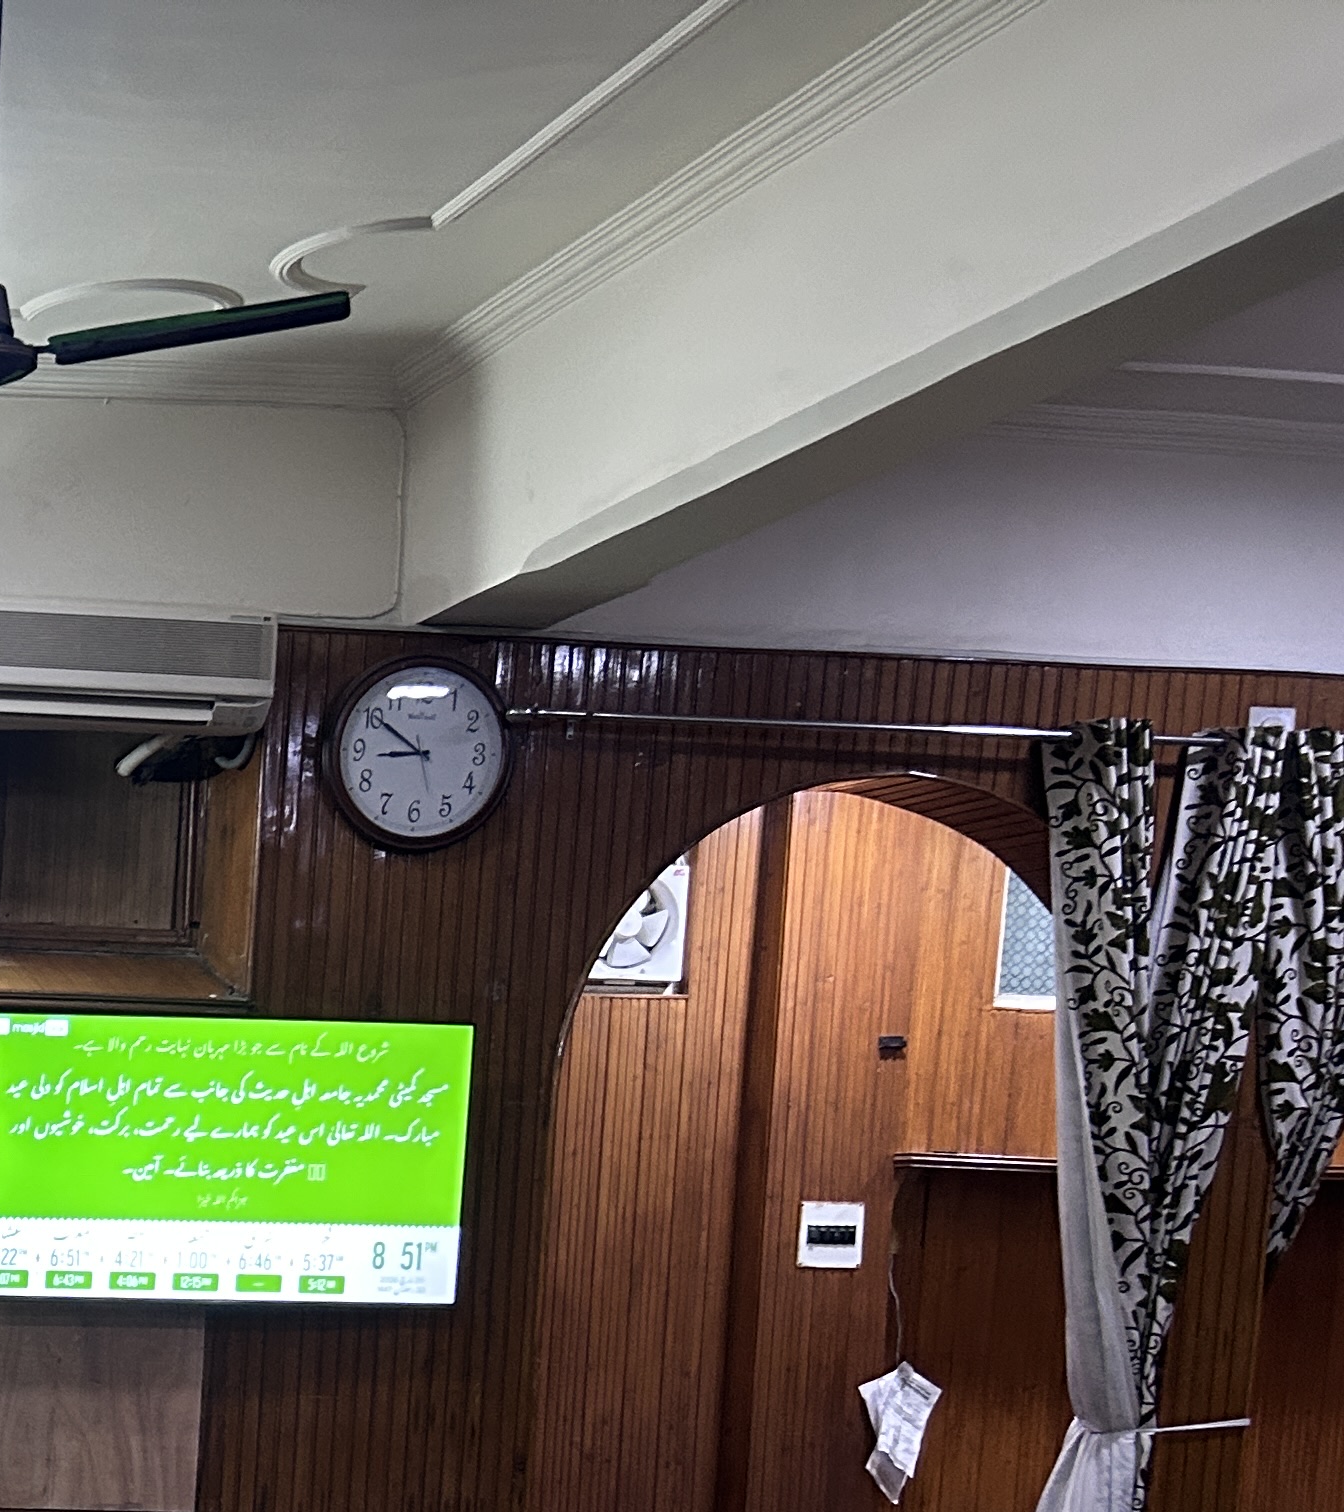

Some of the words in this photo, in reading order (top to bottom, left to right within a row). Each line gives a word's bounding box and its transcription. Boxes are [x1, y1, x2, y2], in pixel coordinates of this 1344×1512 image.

[363, 707, 384, 730] 10
[466, 710, 480, 733] 2
[352, 738, 366, 762] 9
[472, 742, 486, 766] 3
[359, 768, 373, 793] 8
[462, 771, 475, 795] 4
[380, 792, 393, 815] 7
[407, 800, 421, 823] 6
[438, 794, 453, 818] 5
[107, 1036, 126, 1052] والا
[155, 1038, 192, 1058] نہایت
[194, 1040, 230, 1060] مہربان
[250, 1042, 263, 1056] جو
[265, 1043, 286, 1056] سے
[288, 1041, 308, 1064] نام
[310, 1032, 331, 1057] کے
[356, 1041, 390, 1063] شروع
[53, 1067, 73, 1096] کو
[66, 1078, 103, 1105] اسلام
[132, 1077, 164, 1107] تمام
[163, 1081, 188, 1098] سے
[191, 1080, 229, 1103] جانب
[231, 1070, 255, 1104] کی
[249, 1081, 290, 1101] حدیث
[353, 1078, 389, 1108] محمدیہ
[389, 1067, 425, 1108] کمیٹی
[417, 1083, 449, 1107] مسجد
[9, 1116, 31, 1135] اور
[210, 1121, 260, 1139] ہمارے
[261, 1113, 281, 1139] کو
[274, 1124, 296, 1143] عید
[298, 1122, 325, 1145] اس
[245, 1158, 259, 1178] کا
[50, 1249, 81, 1267] 6:51
[425, 1241, 438, 1253] PM
[115, 1250, 143, 1268] 421
[239, 1252, 272, 1270] 6:46
[303, 1253, 334, 1271] 5:37
